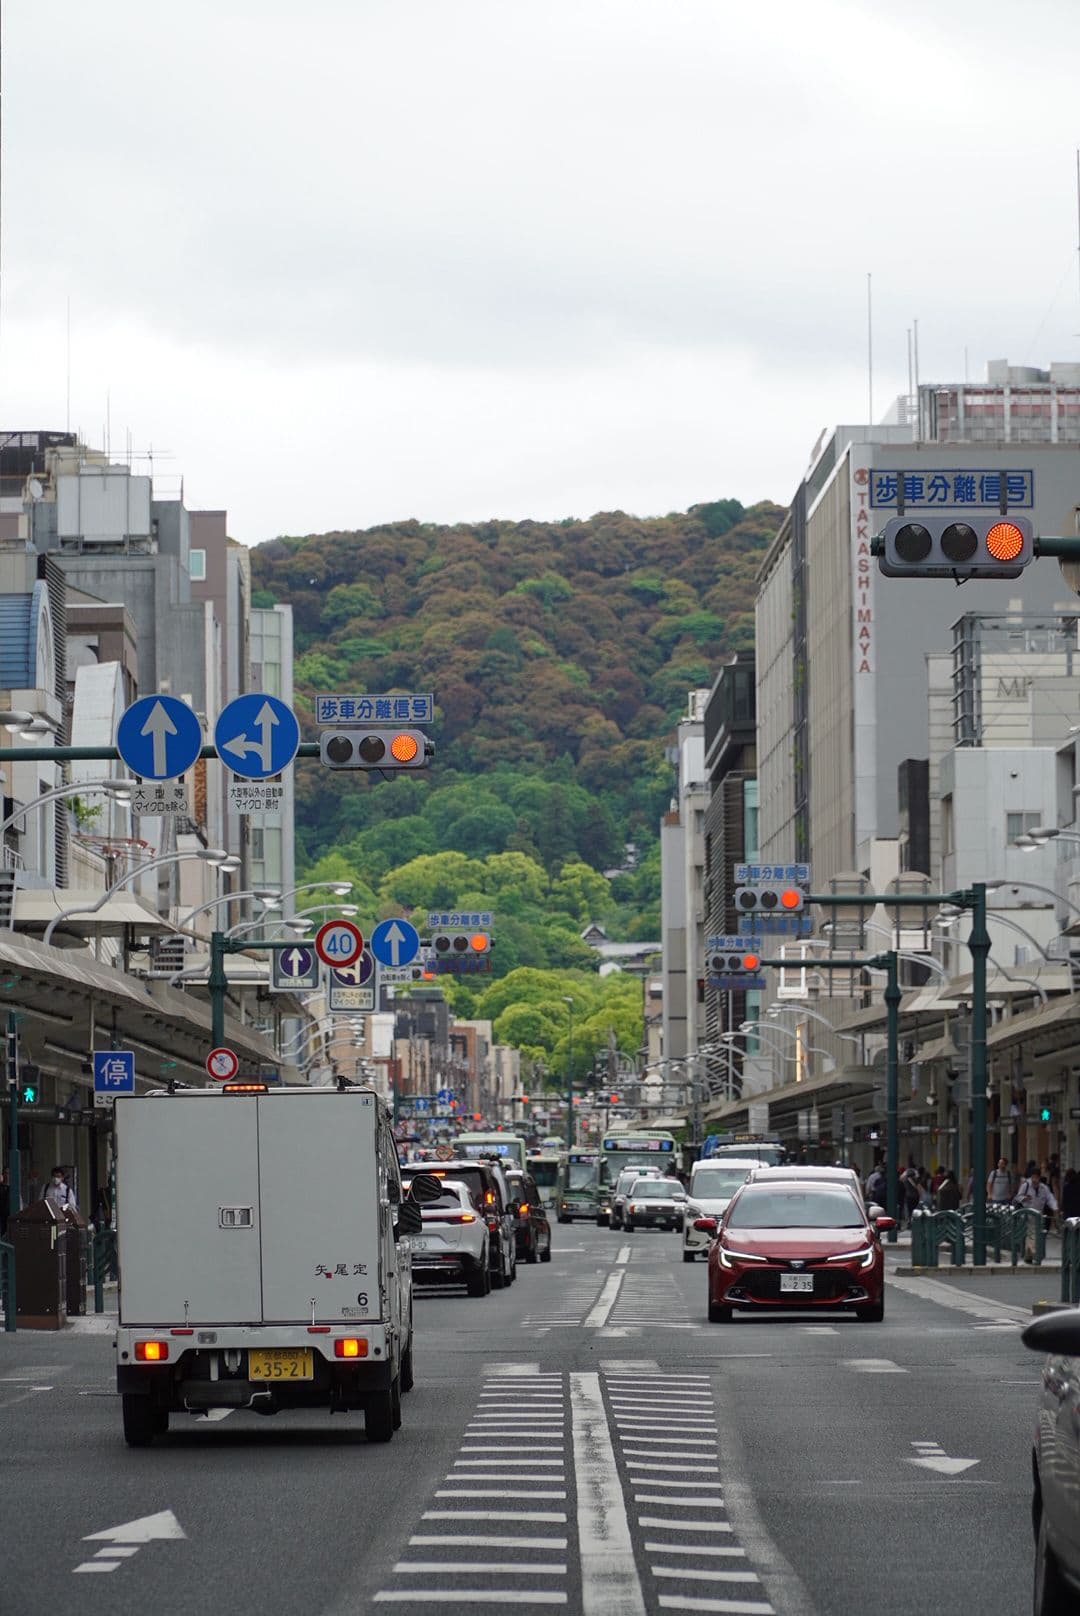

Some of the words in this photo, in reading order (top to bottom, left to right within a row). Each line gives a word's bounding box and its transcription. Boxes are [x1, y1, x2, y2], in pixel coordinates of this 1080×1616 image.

[876, 475, 1027, 503] 歩車分離信号
[857, 492, 871, 672] TAKASHIMAYA
[321, 699, 428, 720] 歩車分離信号
[230, 788, 284, 798] 大型等以外の自動車
[430, 914, 490, 926] 歩車分離信号
[327, 934, 352, 954] 40
[100, 1058, 128, 1085] 停
[315, 1264, 368, 1276] 矢尾定
[357, 1292, 369, 1306] 6
[264, 1361, 306, 1377] 35-21
